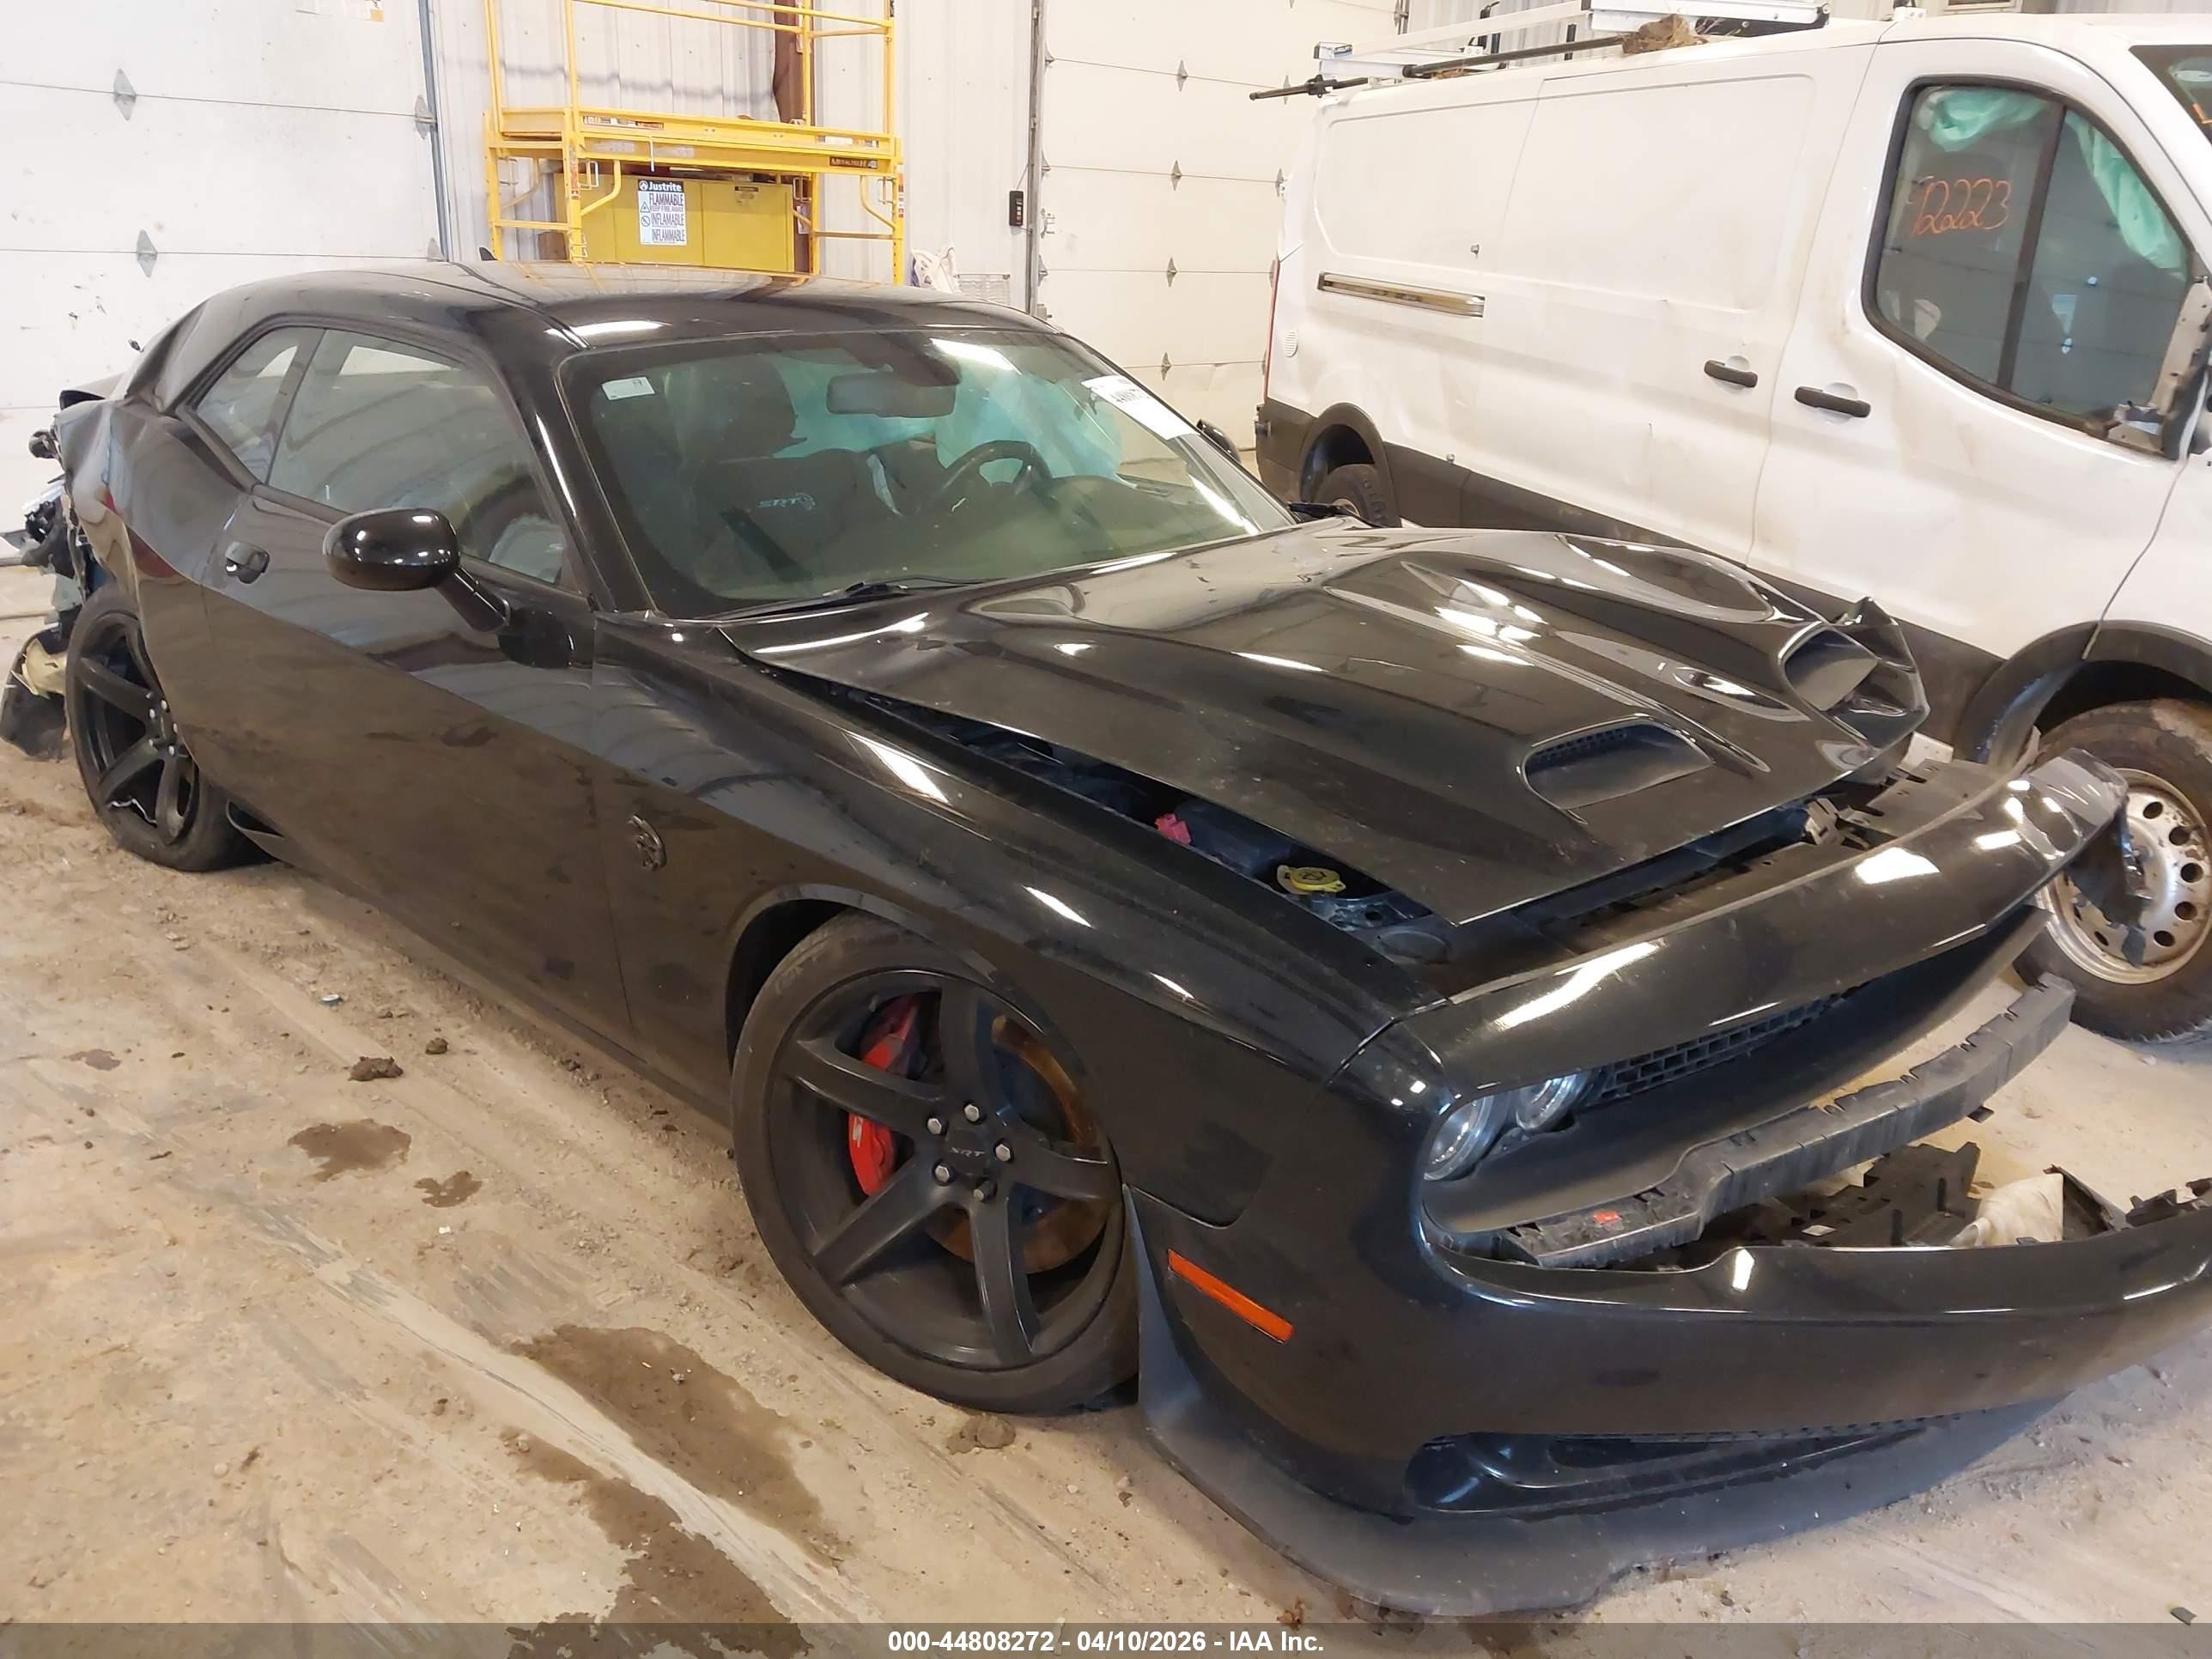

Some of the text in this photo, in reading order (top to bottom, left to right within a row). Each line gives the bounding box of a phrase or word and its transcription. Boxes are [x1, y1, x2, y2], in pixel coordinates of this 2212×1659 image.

[649, 182, 682, 191] Justrite
[649, 193, 684, 206] FLAMMABLE
[651, 213, 684, 226] INFLAMABLE
